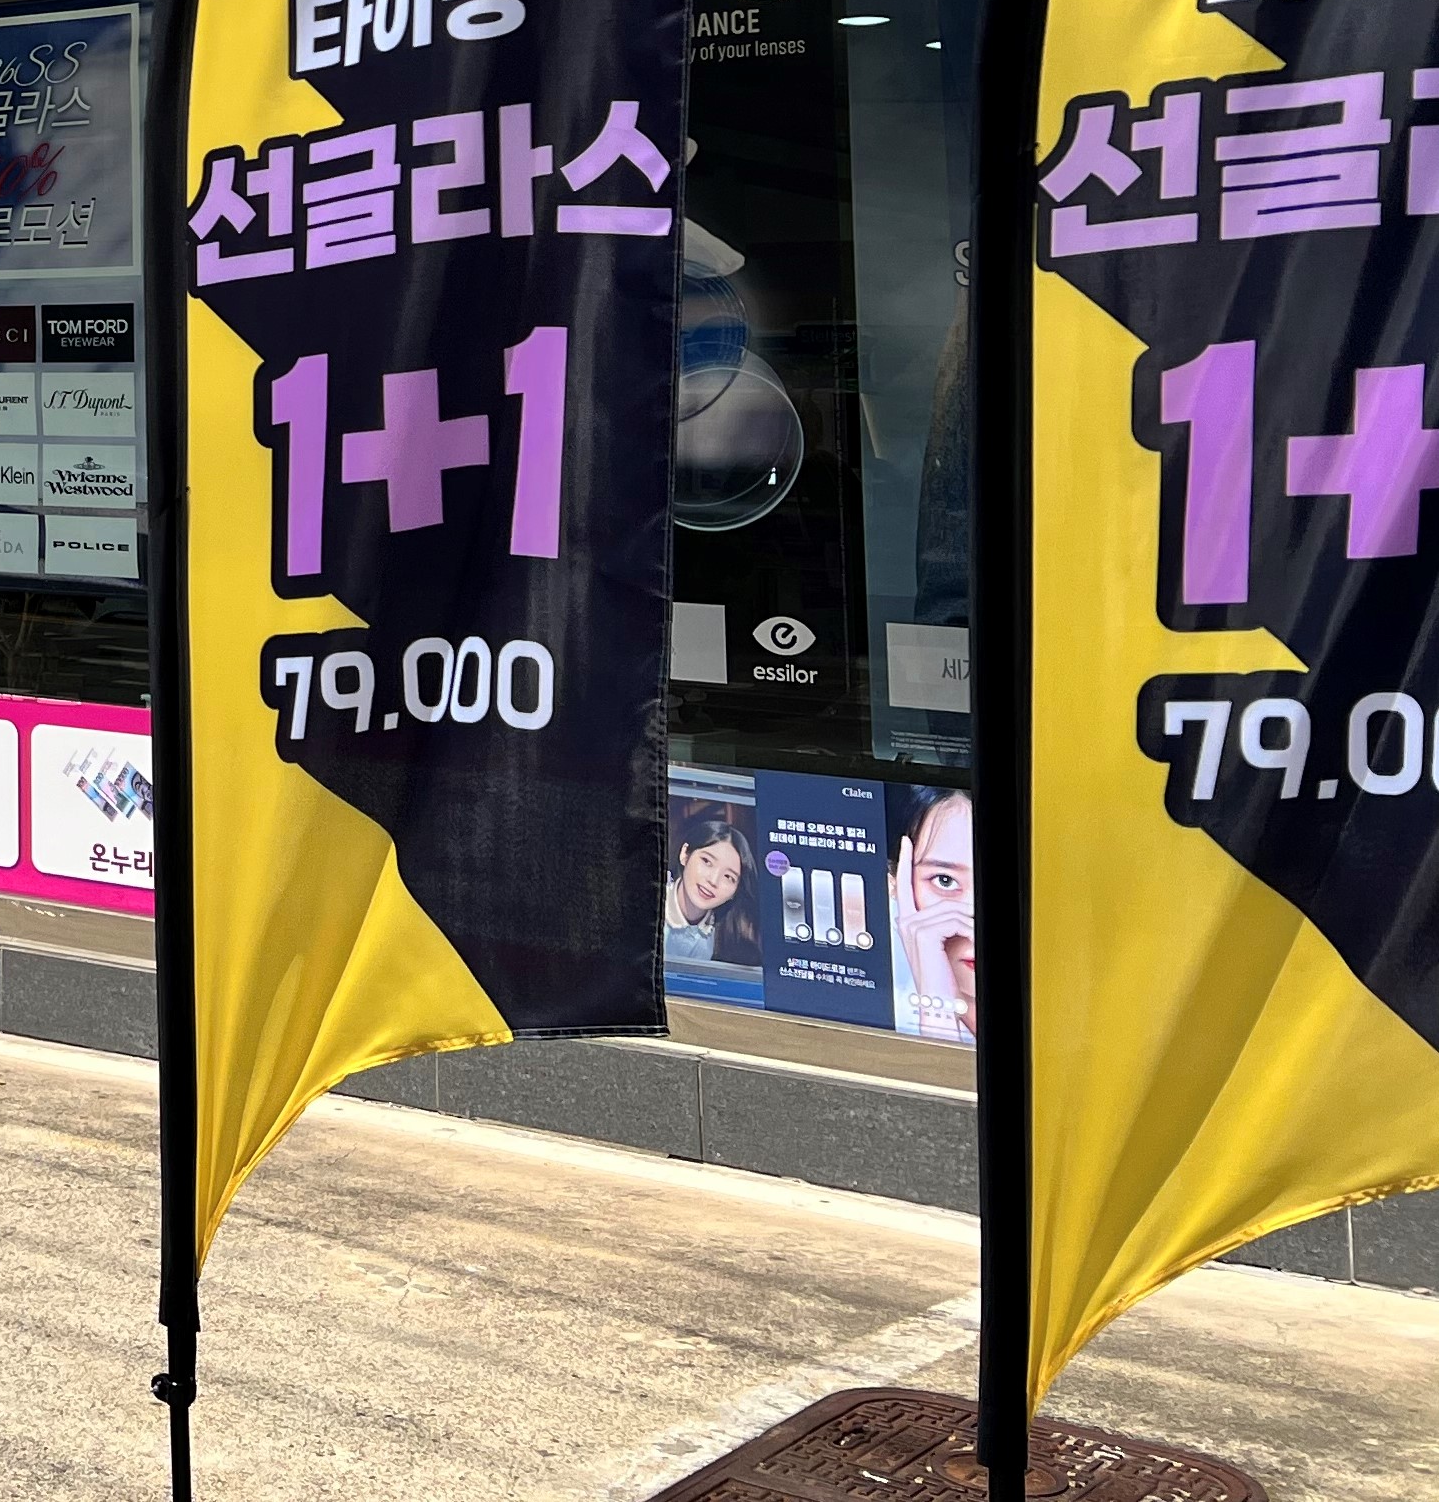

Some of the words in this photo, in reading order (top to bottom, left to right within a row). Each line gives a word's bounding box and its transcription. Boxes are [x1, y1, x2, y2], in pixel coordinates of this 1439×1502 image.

[690, 9, 760, 38] ANCE
[700, 43, 717, 61] of
[717, 43, 751, 64] your
[755, 38, 806, 57] lenses
[1040, 67, 1439, 258] 선글
[187, 100, 673, 287] 선글라스
[47, 320, 83, 335] TOM
[85, 319, 129, 334] FORD
[61, 336, 115, 347] EYEWEAR
[271, 326, 568, 577] 1+1
[1, 466, 35, 485] Klein
[52, 469, 128, 484] Vivienne
[44, 481, 133, 497] Westwood
[52, 541, 130, 552] POLICE
[753, 664, 818, 684] essilor
[275, 636, 555, 740] 79.000
[1163, 692, 1439, 800] 79.0
[842, 787, 873, 800] Clalen
[89, 843, 153, 877] 온누리
